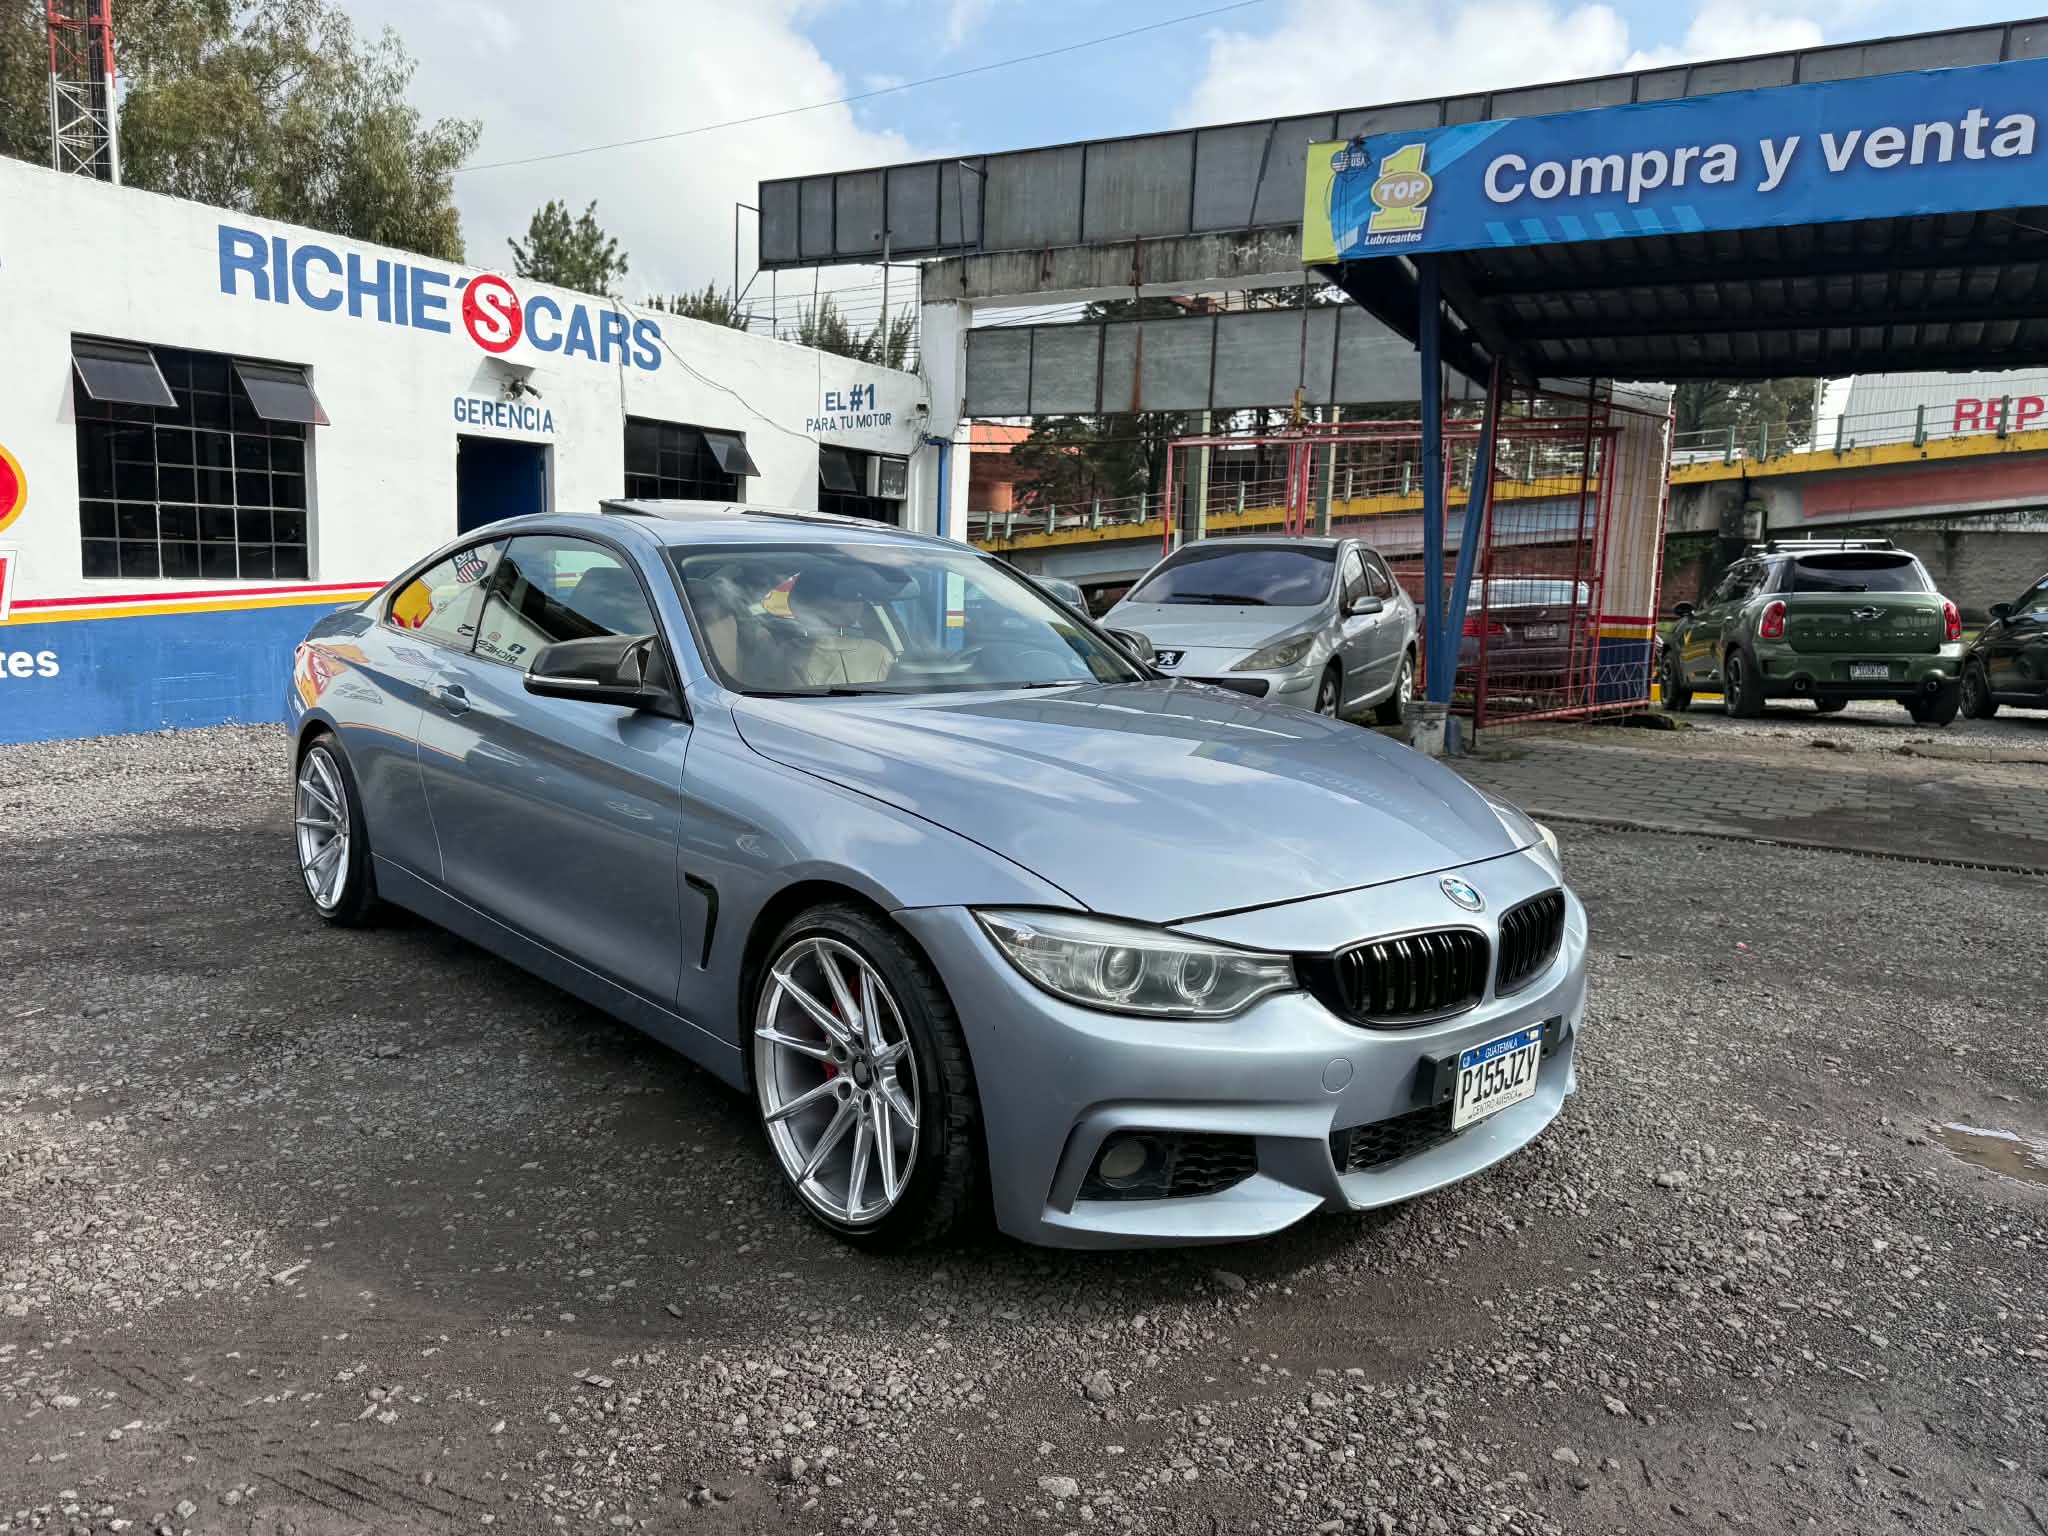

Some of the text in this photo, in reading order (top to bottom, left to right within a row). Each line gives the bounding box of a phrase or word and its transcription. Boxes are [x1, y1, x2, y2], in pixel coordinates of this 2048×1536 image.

[1484, 108, 2036, 204] Compra y venta
[1380, 180, 1425, 201] TOP
[1364, 231, 1422, 245] Lubricantes
[524, 295, 662, 371] CARS
[825, 383, 875, 412] EL #1
[454, 397, 555, 434] GERENCIA
[806, 412, 892, 432] PARA TU MOTOR
[1460, 1044, 1537, 1109] P155JZY
